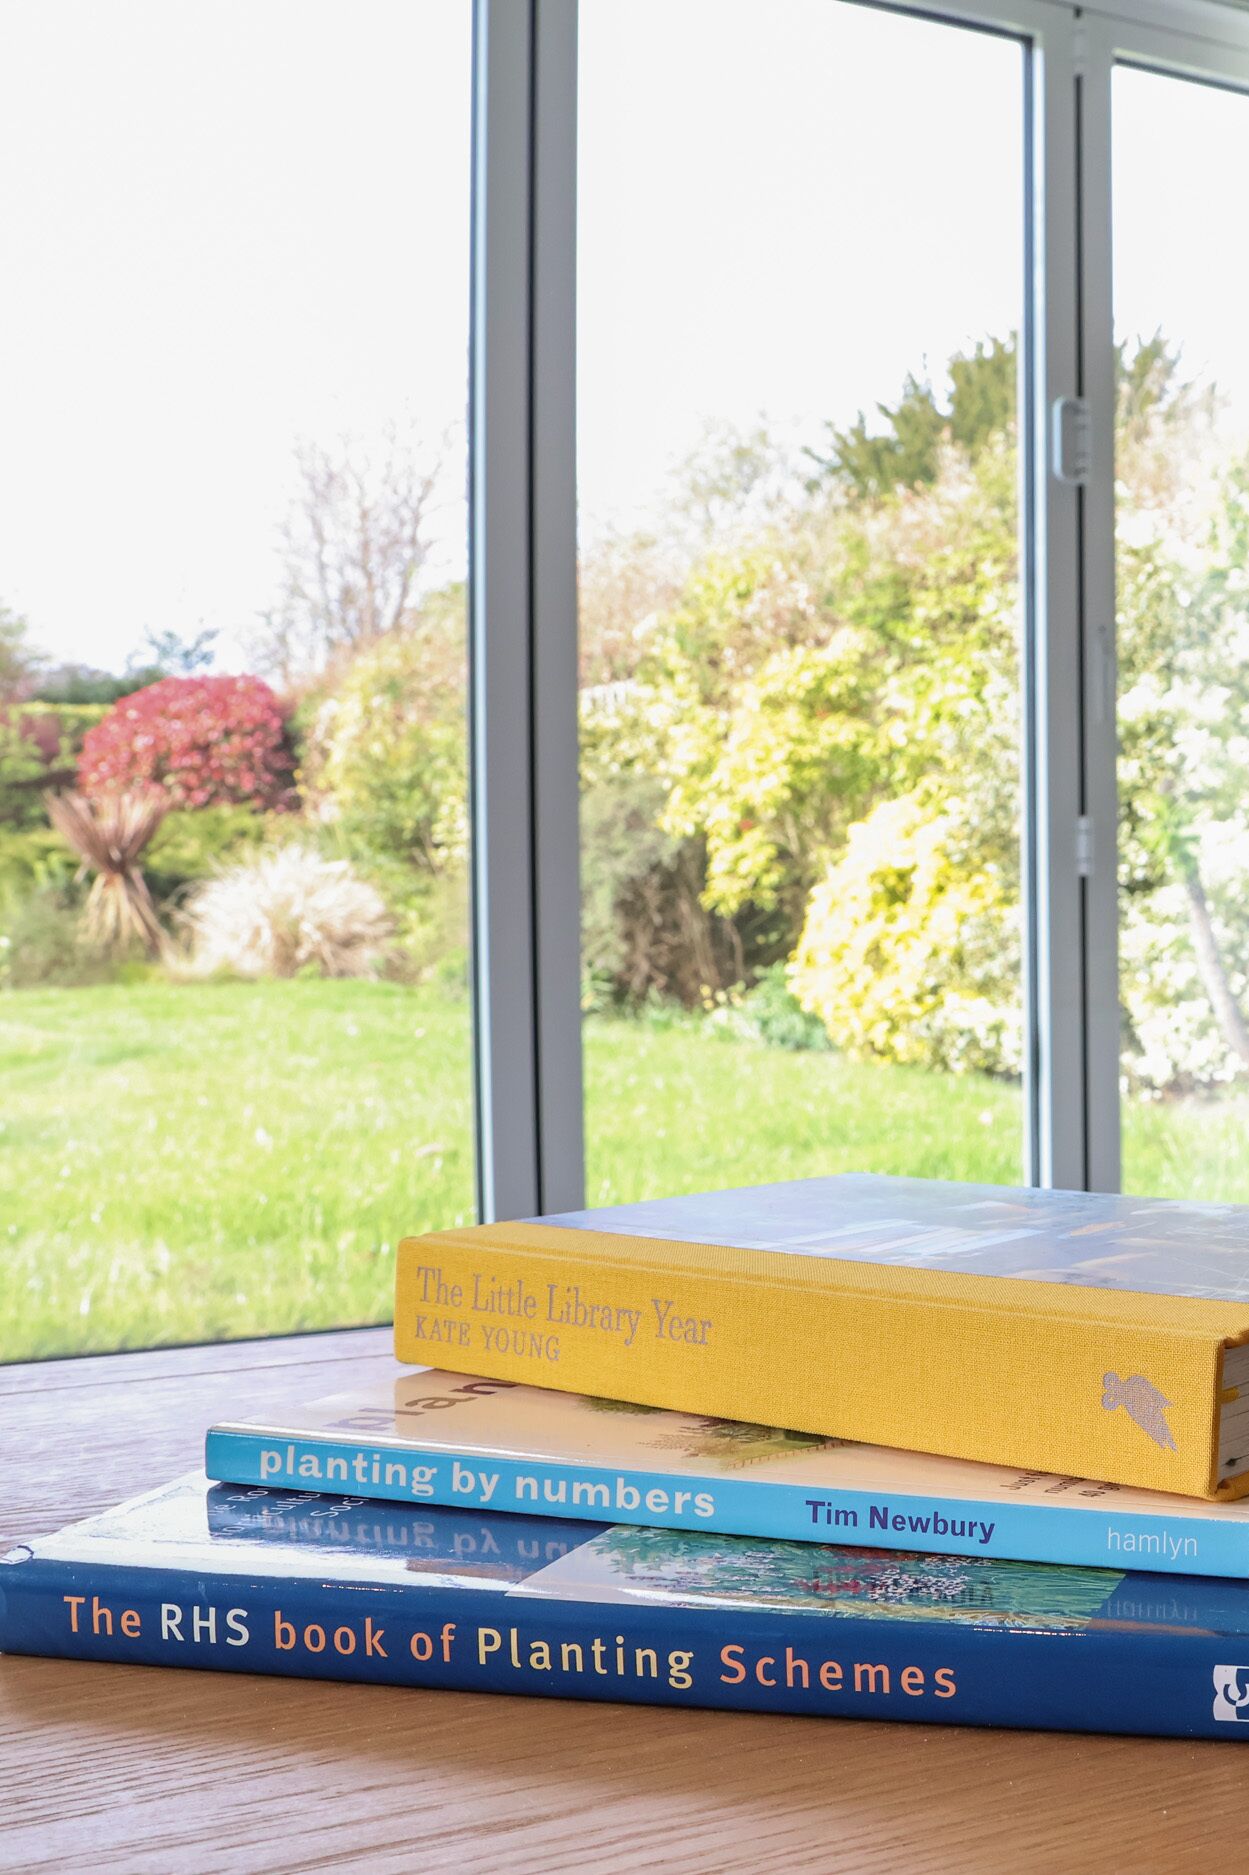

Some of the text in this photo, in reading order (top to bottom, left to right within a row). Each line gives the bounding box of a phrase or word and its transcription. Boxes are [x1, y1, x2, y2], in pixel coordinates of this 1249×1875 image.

[416, 1265, 714, 1346] The Little Library Year
[414, 1315, 561, 1361] KATE YOUNG
[323, 1382, 518, 1432] plan
[225, 1487, 271, 1503] Ro
[259, 1444, 716, 1518] planting by numbers
[310, 1496, 369, 1518] Soci
[805, 1499, 996, 1545] Tim Newbury
[1106, 1527, 1199, 1558] hamlyn
[63, 1595, 958, 1698] The RHS book of Planting Schemes
